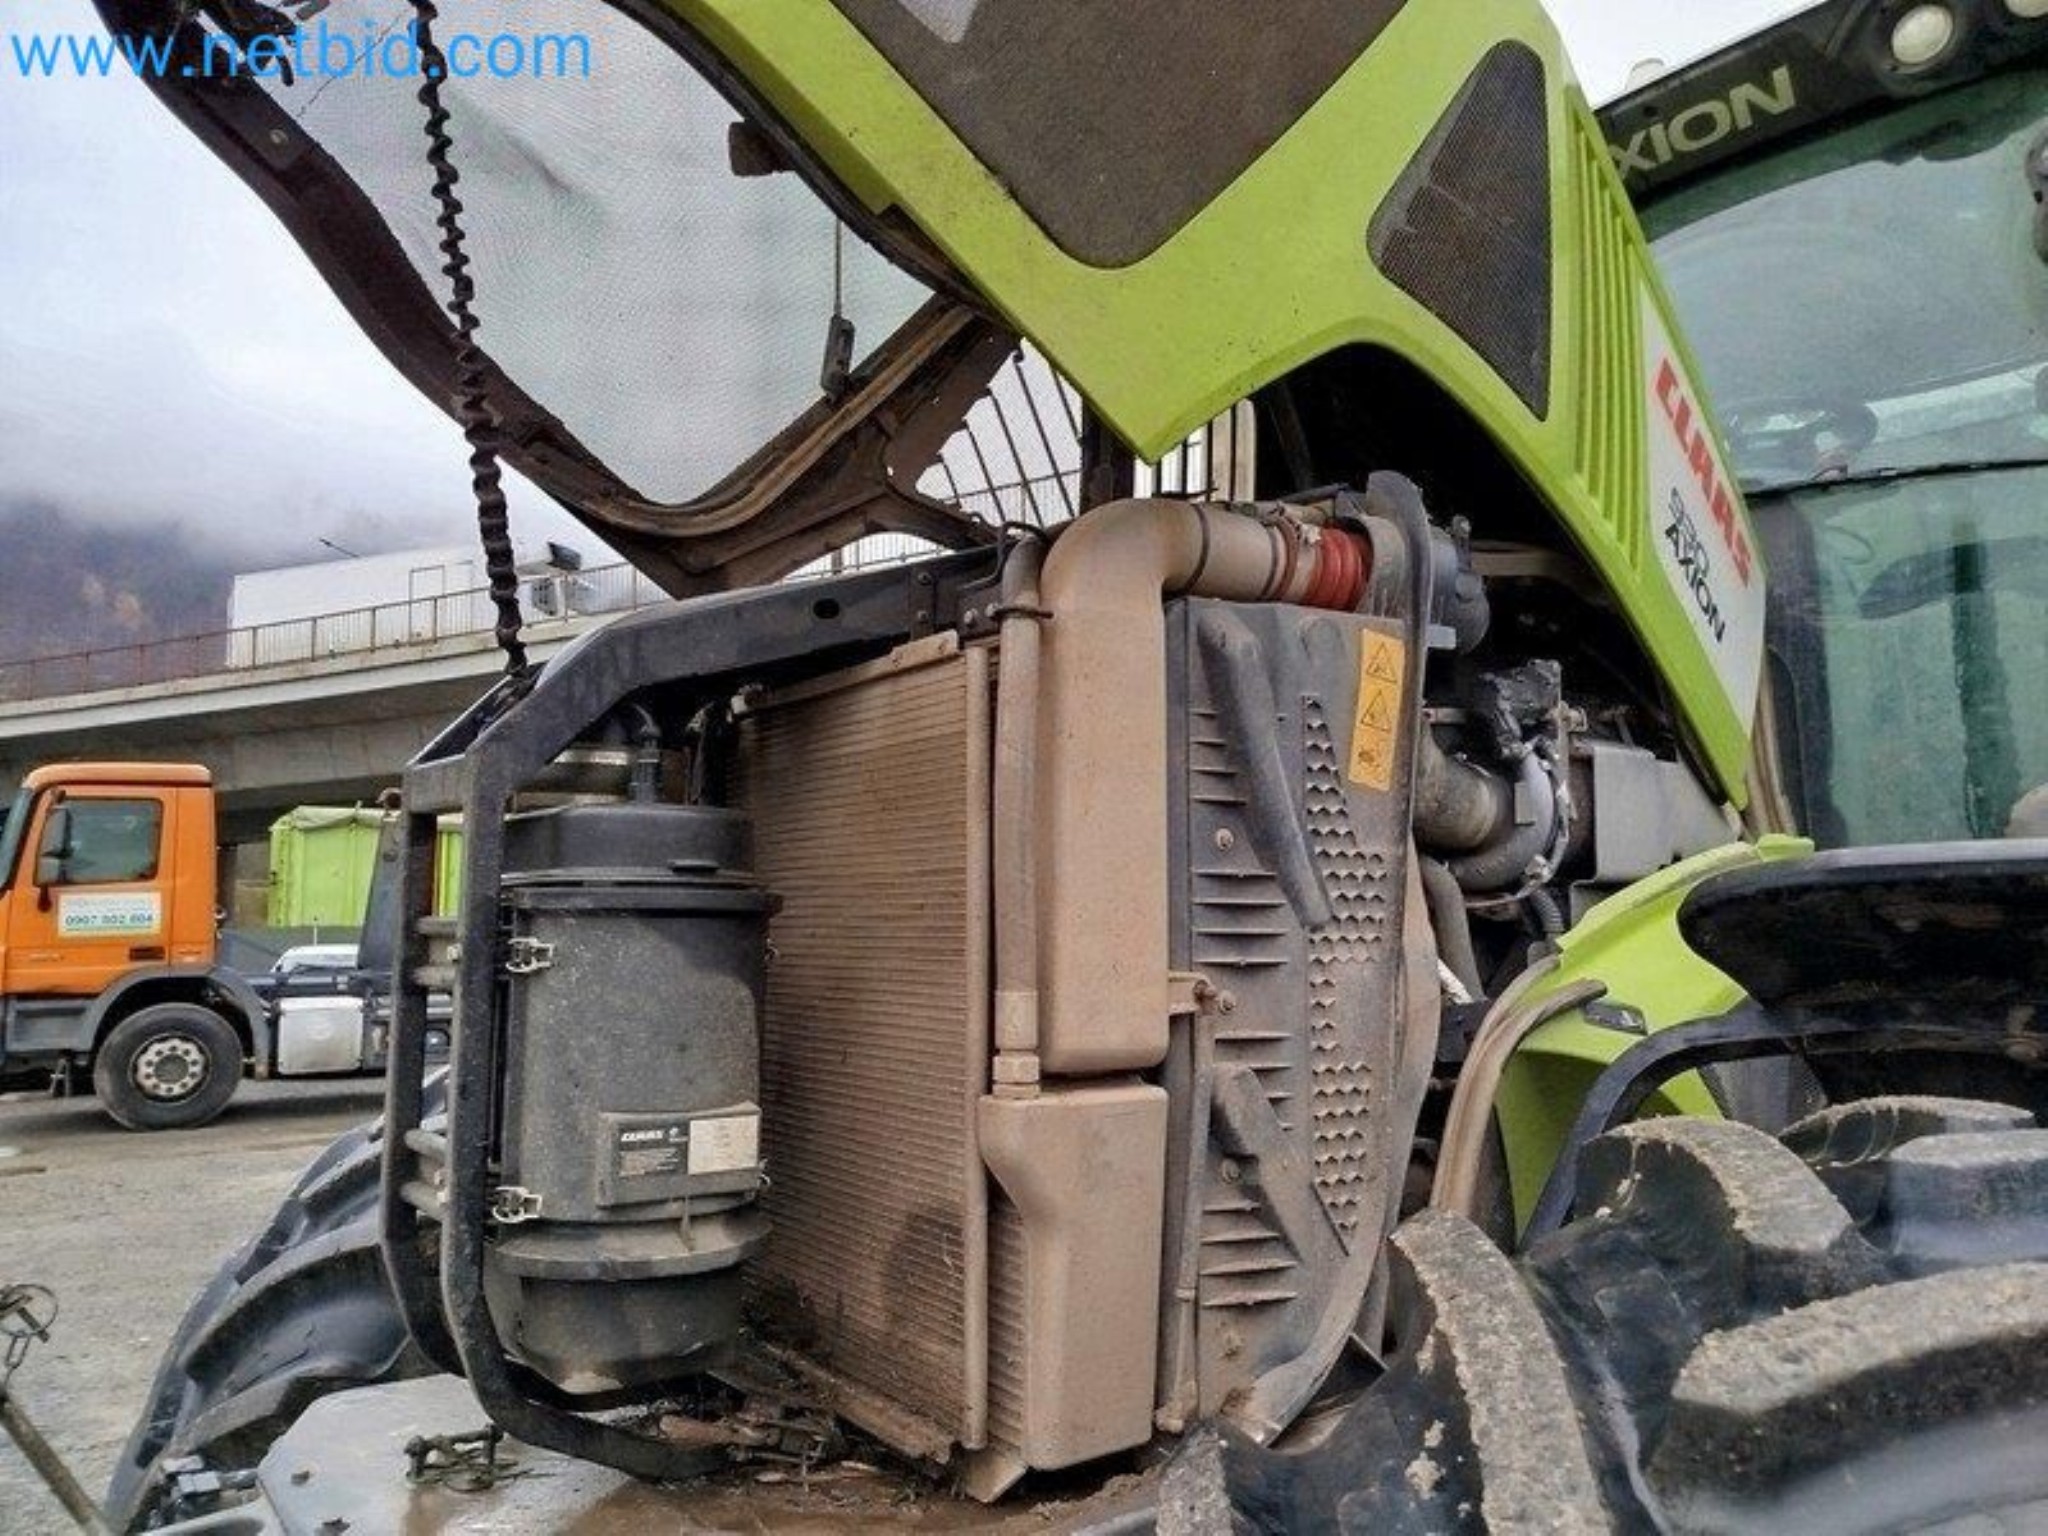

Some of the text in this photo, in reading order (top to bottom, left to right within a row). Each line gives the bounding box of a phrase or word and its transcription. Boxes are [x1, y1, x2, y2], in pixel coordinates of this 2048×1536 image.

[1608, 65, 1796, 179] XION
[1656, 358, 1751, 589] CLAAS
[1665, 523, 1726, 643] AXION
